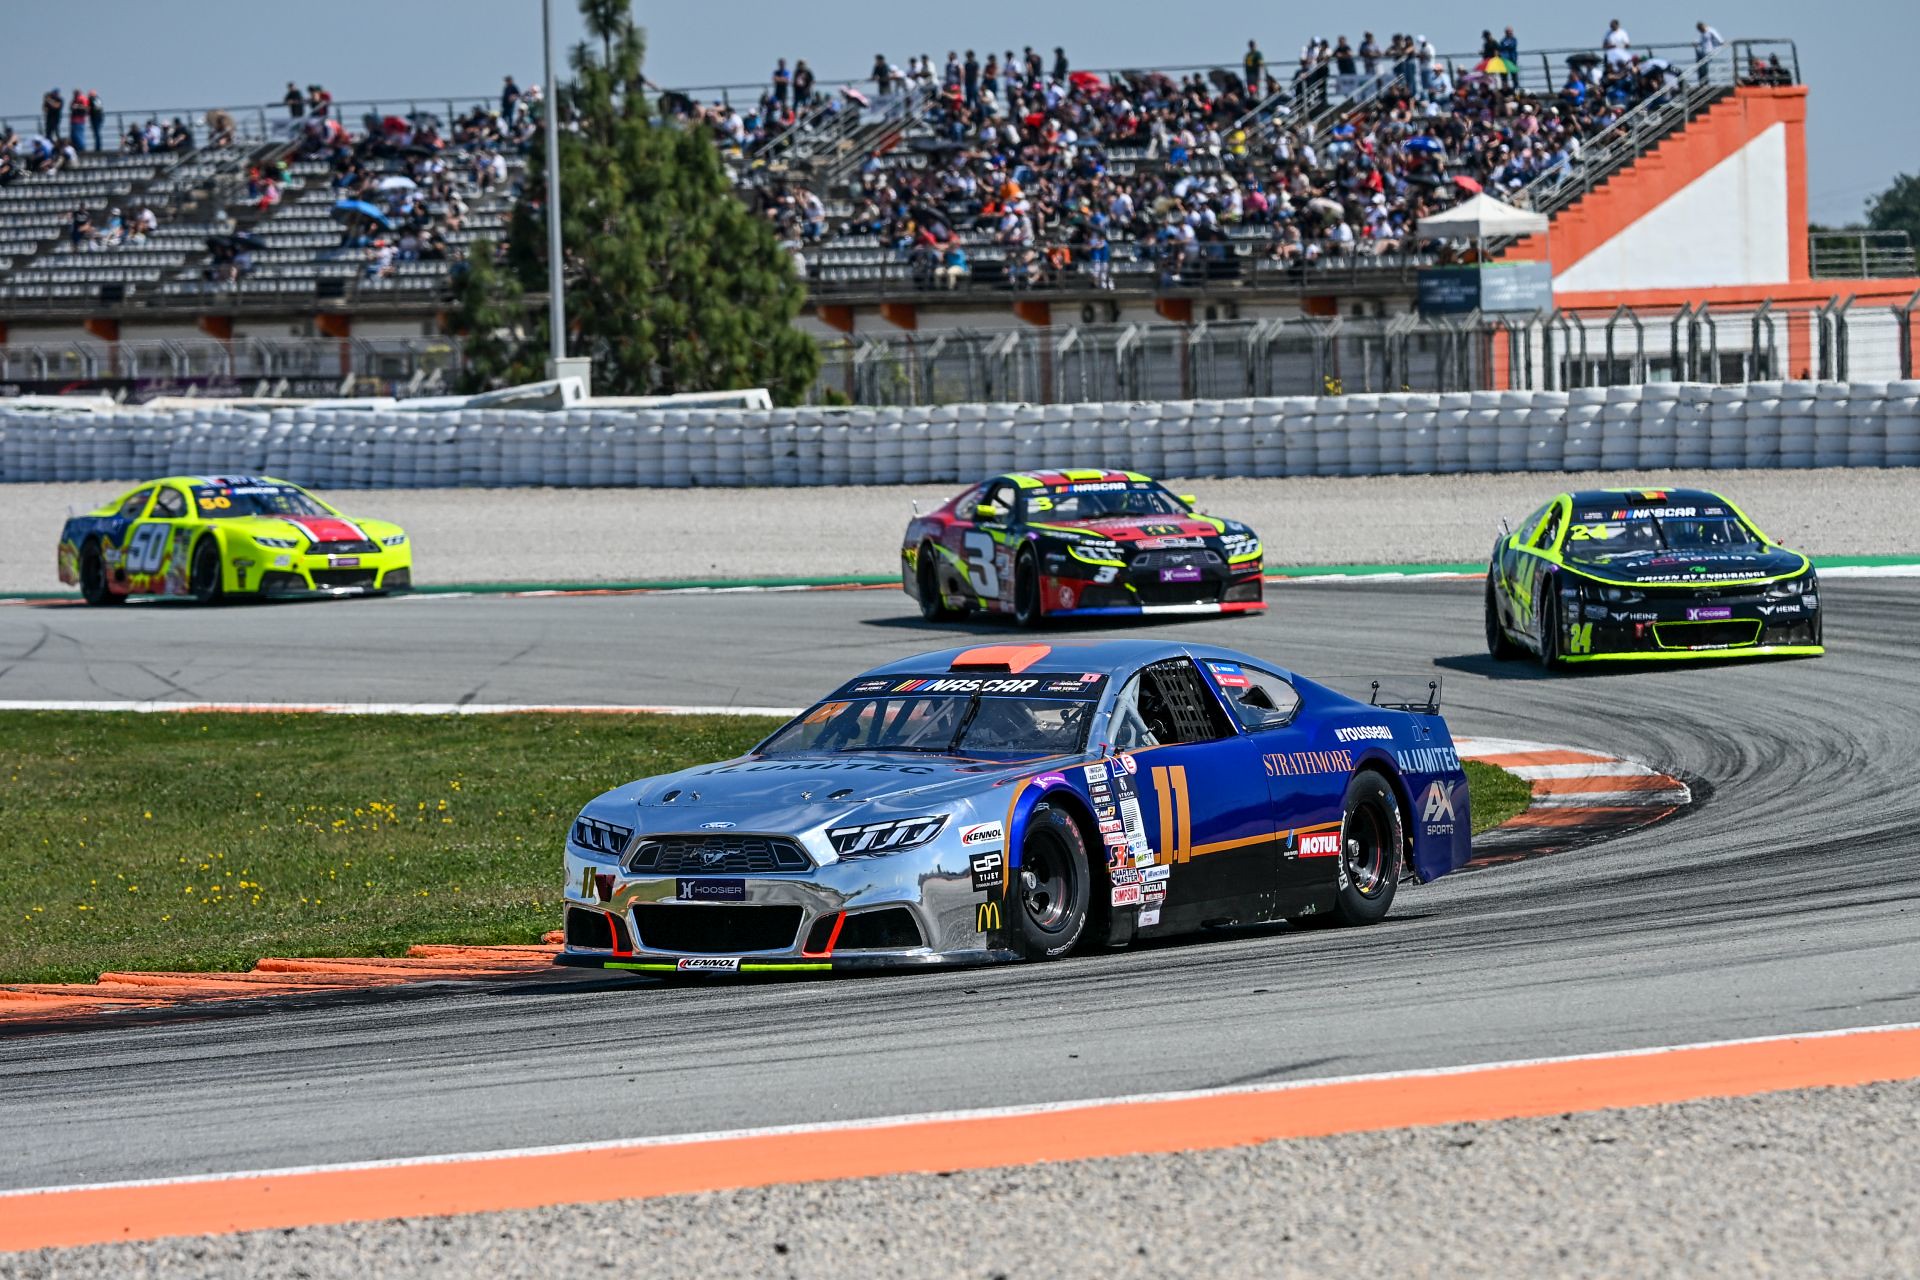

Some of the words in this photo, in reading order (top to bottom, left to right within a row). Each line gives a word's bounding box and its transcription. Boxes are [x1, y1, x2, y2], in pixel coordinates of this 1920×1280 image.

[1073, 482, 1127, 493] NASCAR
[199, 496, 232, 511] 50
[1633, 507, 1696, 519] NASCAR
[1570, 524, 1609, 541] 24
[127, 523, 172, 573] 50
[965, 531, 1000, 599] 3
[1629, 612, 1659, 621] HEINZ
[1776, 604, 1801, 614] HEINZ
[1570, 623, 1593, 653] 24
[927, 679, 1039, 692] NASCAR
[1343, 725, 1393, 742] rousseau
[1262, 749, 1356, 777] STRATHMORE
[1398, 747, 1460, 776] ALUMITEC
[1422, 780, 1456, 822] AX
[1151, 766, 1190, 865] 11
[966, 828, 1002, 842] KENNOL
[1427, 824, 1454, 836] SPORTS
[1300, 835, 1340, 855] MOTUL
[979, 871, 999, 882] TIJEY
[694, 886, 742, 895] HOOSIER
[1114, 887, 1138, 903] SIMPSON
[684, 958, 736, 967] KENNOL
